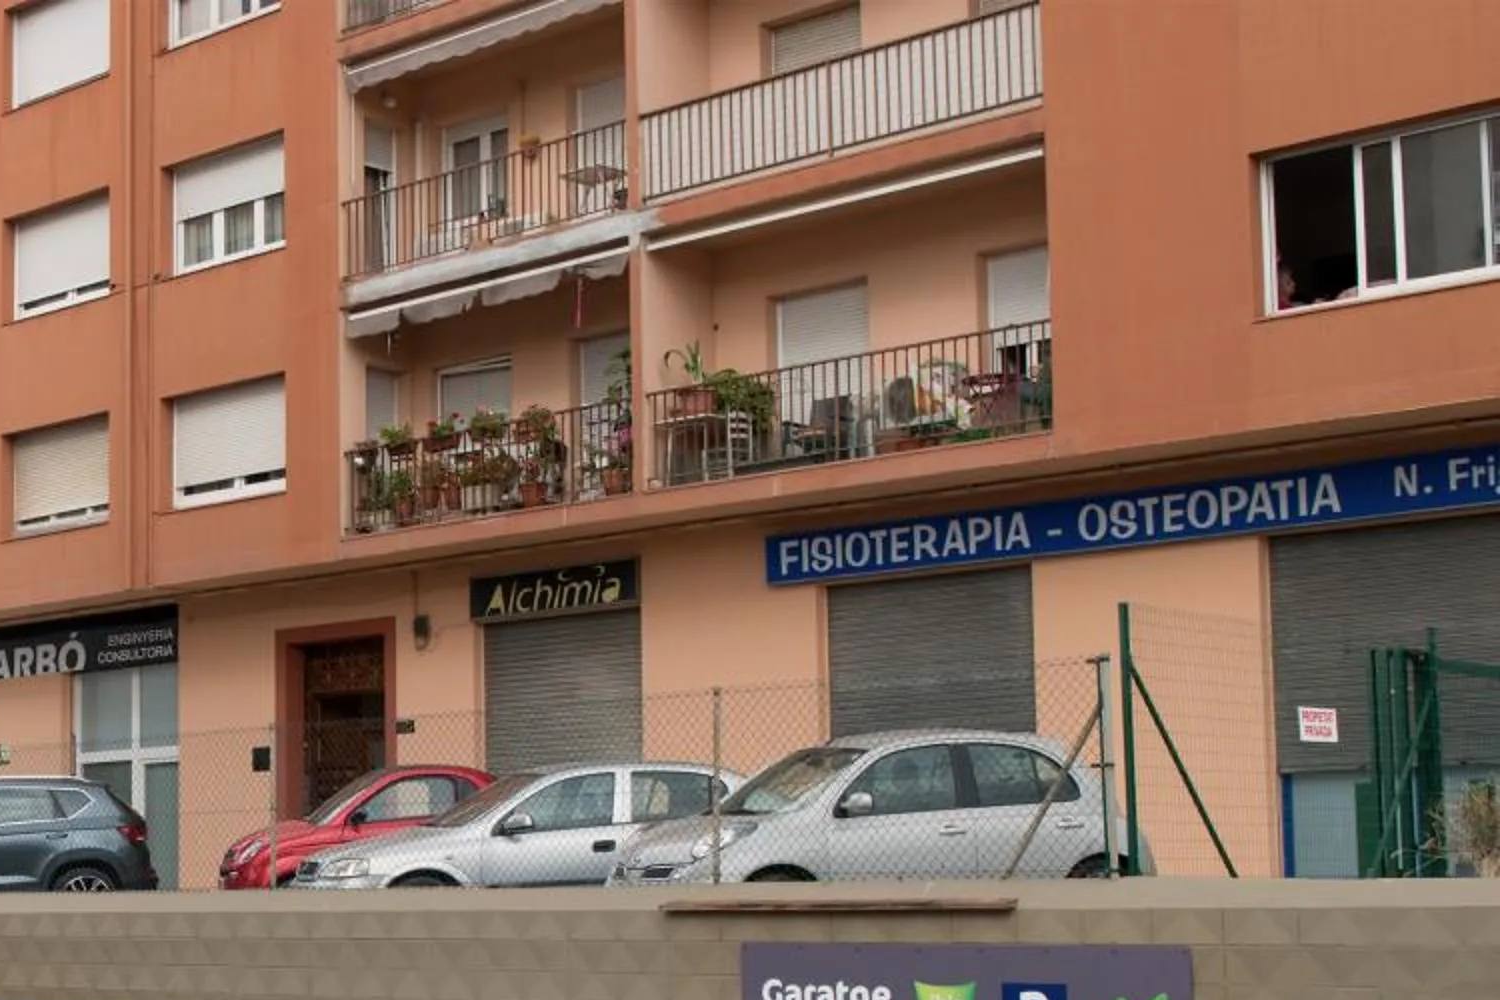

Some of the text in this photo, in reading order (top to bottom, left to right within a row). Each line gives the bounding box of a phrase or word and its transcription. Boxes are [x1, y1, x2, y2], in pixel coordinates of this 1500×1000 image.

[778, 510, 1031, 577] FISIOTERAPIA
[1077, 473, 1342, 542] OSTEOPATIA
[1447, 455, 1500, 496] Fri
[484, 565, 621, 618] Alchimia
